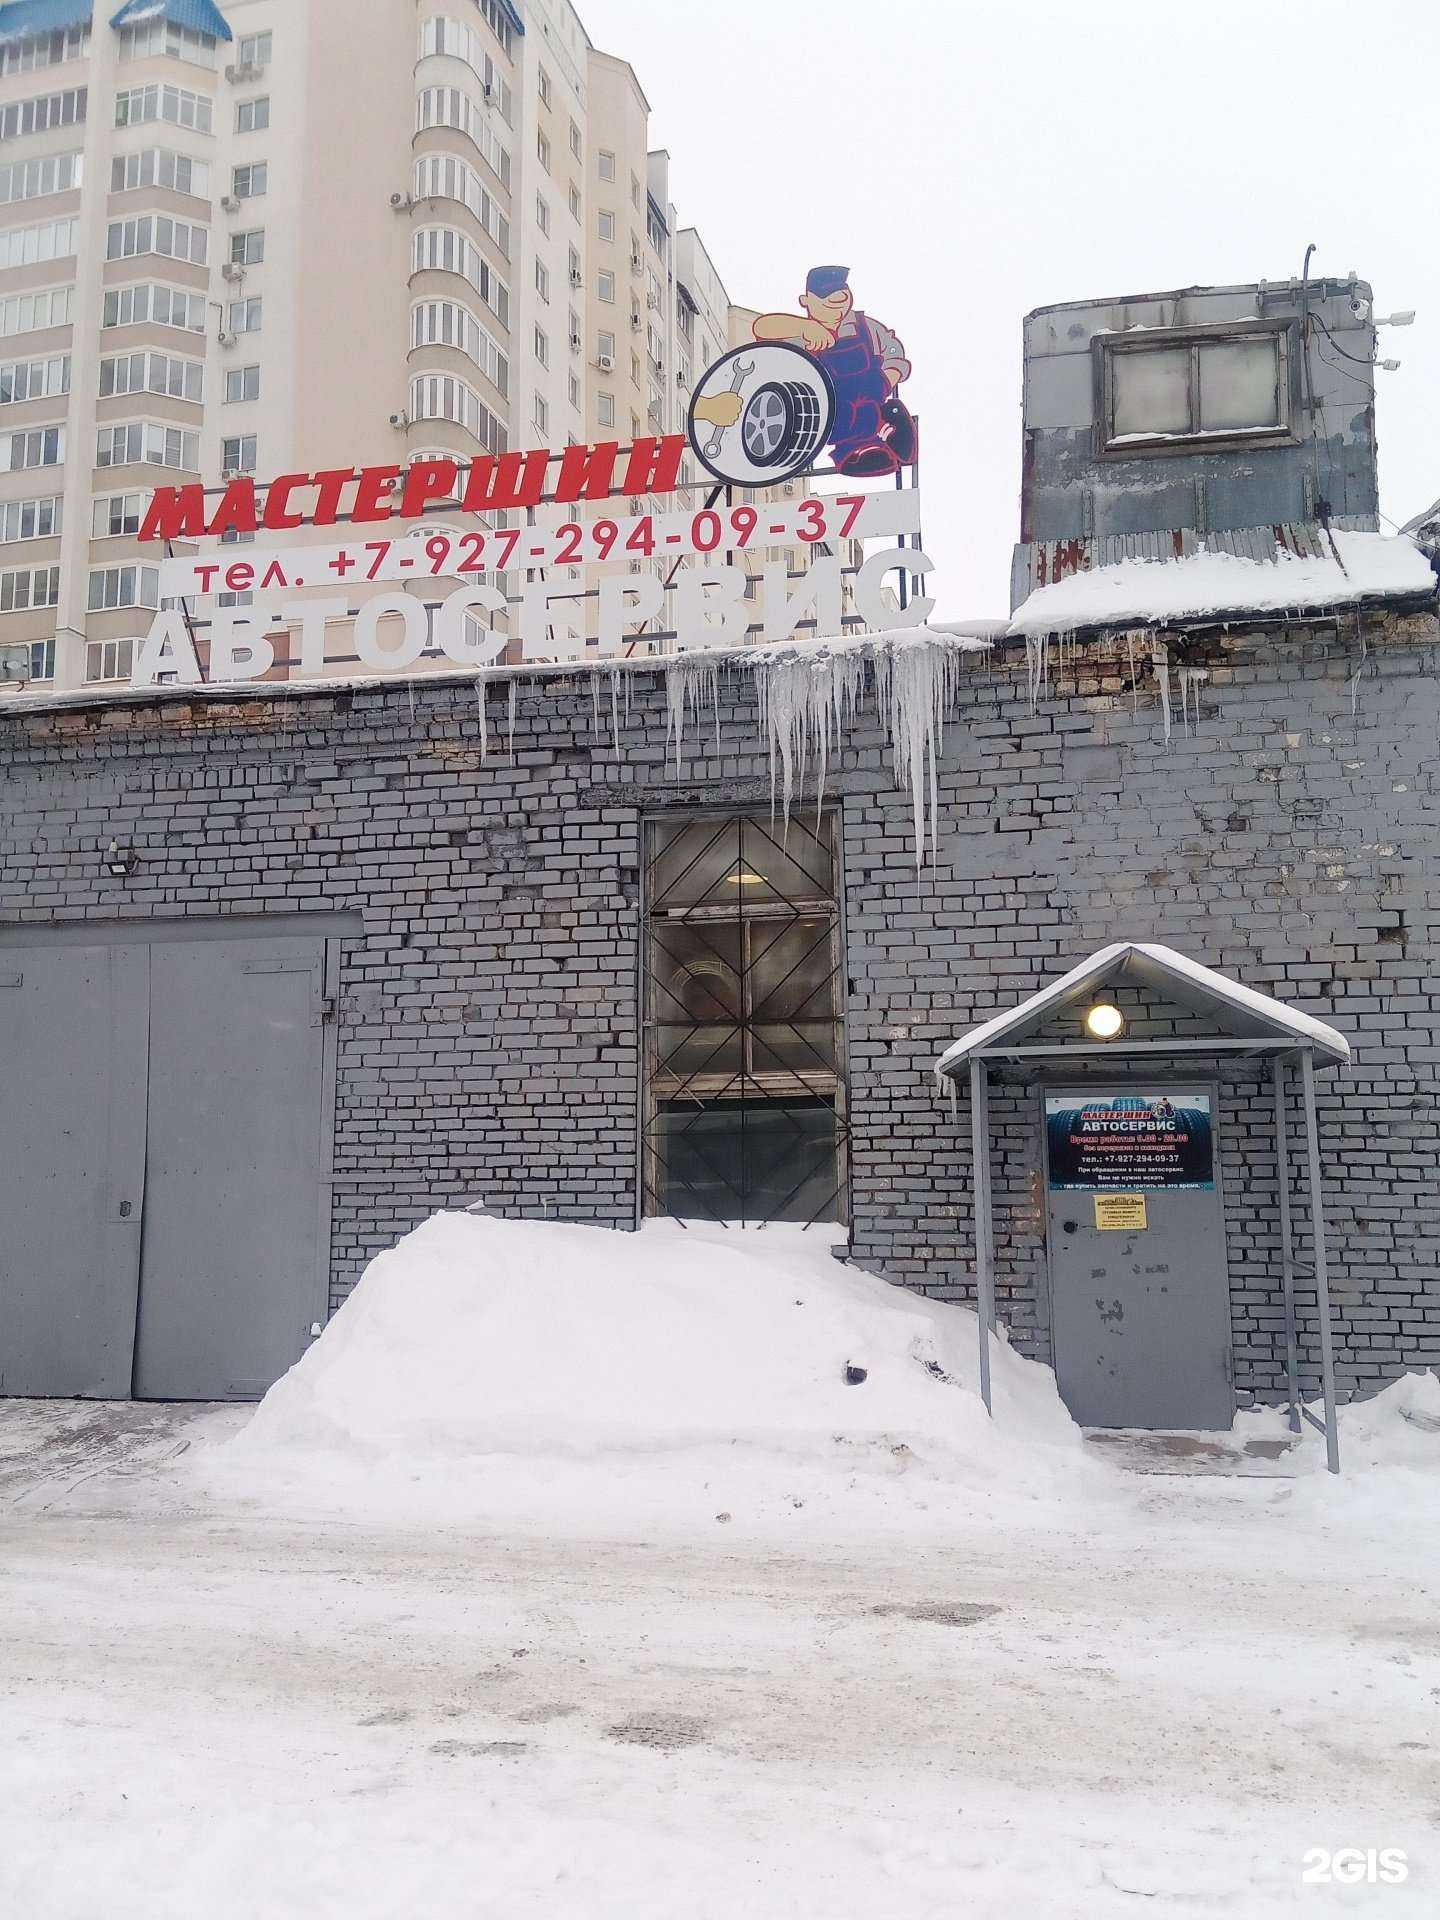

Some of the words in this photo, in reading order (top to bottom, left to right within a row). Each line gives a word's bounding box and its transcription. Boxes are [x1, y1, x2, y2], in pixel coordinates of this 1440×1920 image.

[137, 434, 685, 541] МАСТЕРШИН
[193, 558, 305, 594] тел.
[328, 495, 866, 581] +7-927-294-09-37
[130, 547, 937, 688] АВТОСЕРВИС
[1082, 1121, 1176, 1131] АВТОСЕРВИС
[1105, 1155, 1179, 1163] +7-927-294-09-37
